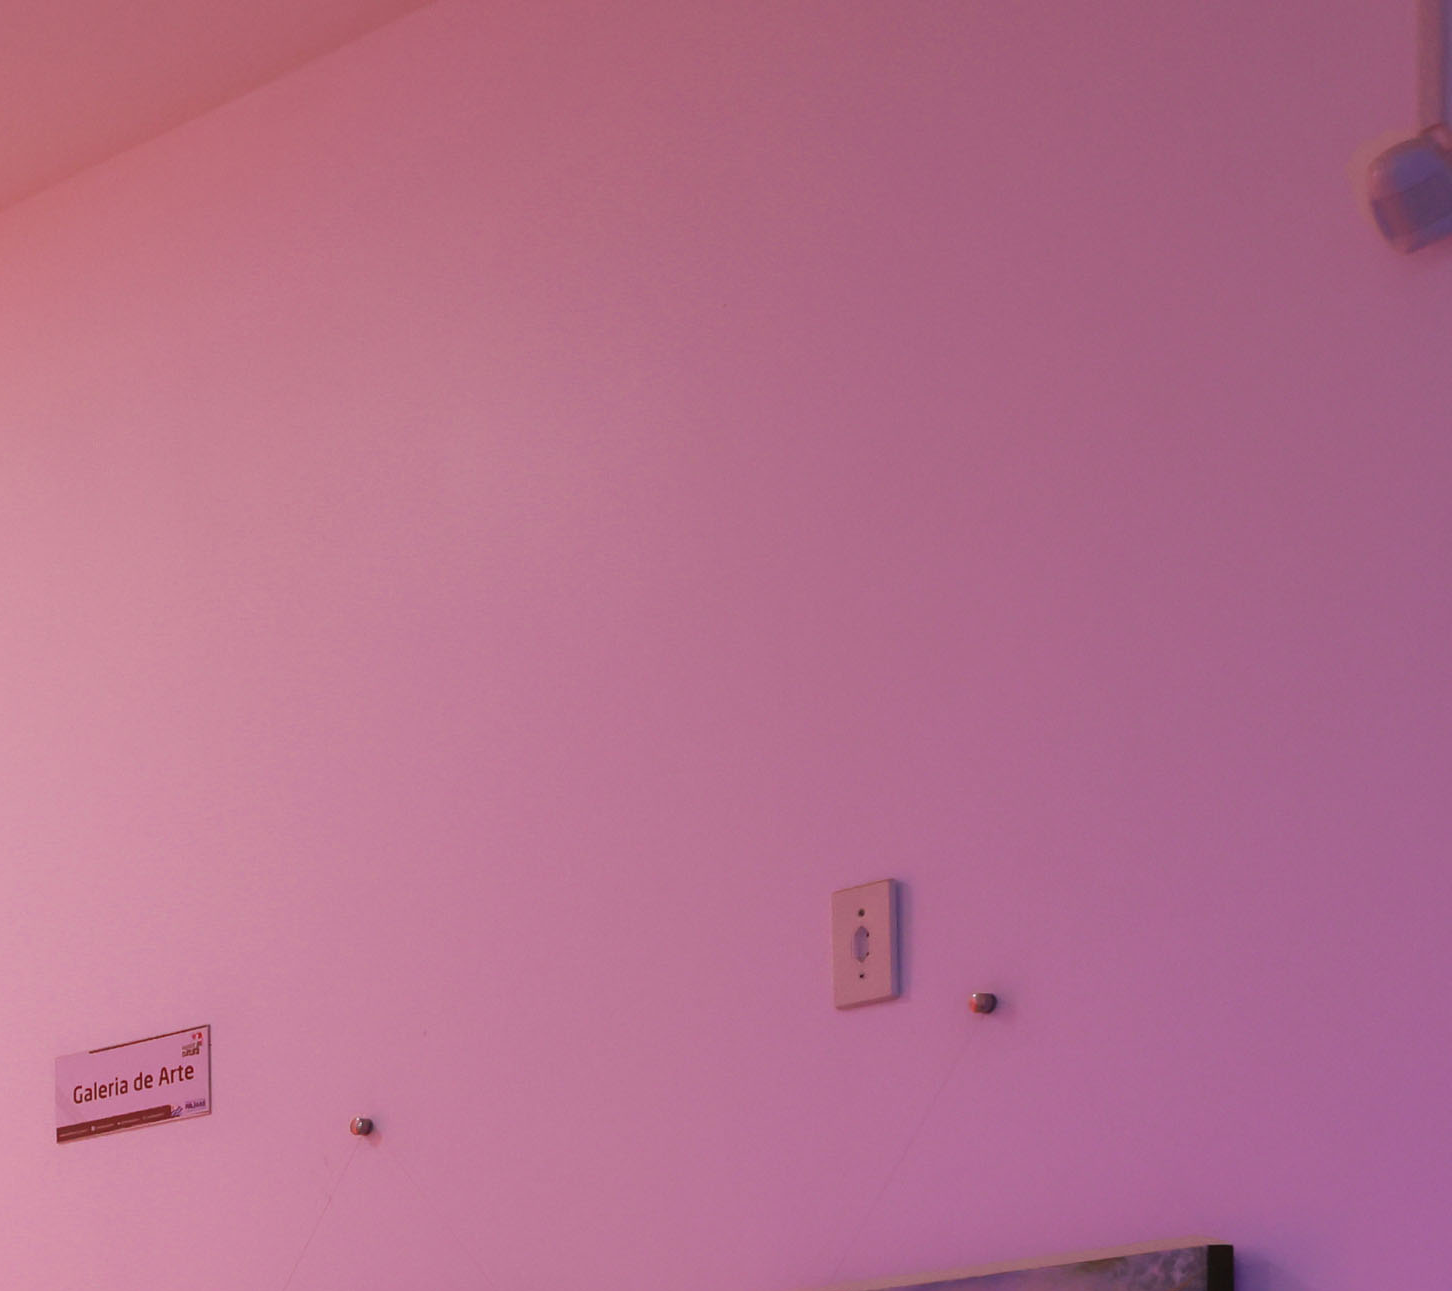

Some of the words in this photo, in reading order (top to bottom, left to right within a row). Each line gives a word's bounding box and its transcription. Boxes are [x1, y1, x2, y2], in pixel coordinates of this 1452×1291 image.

[73, 1076, 129, 1105] Galeria
[134, 1071, 154, 1091] de
[158, 1063, 195, 1087] Arte
